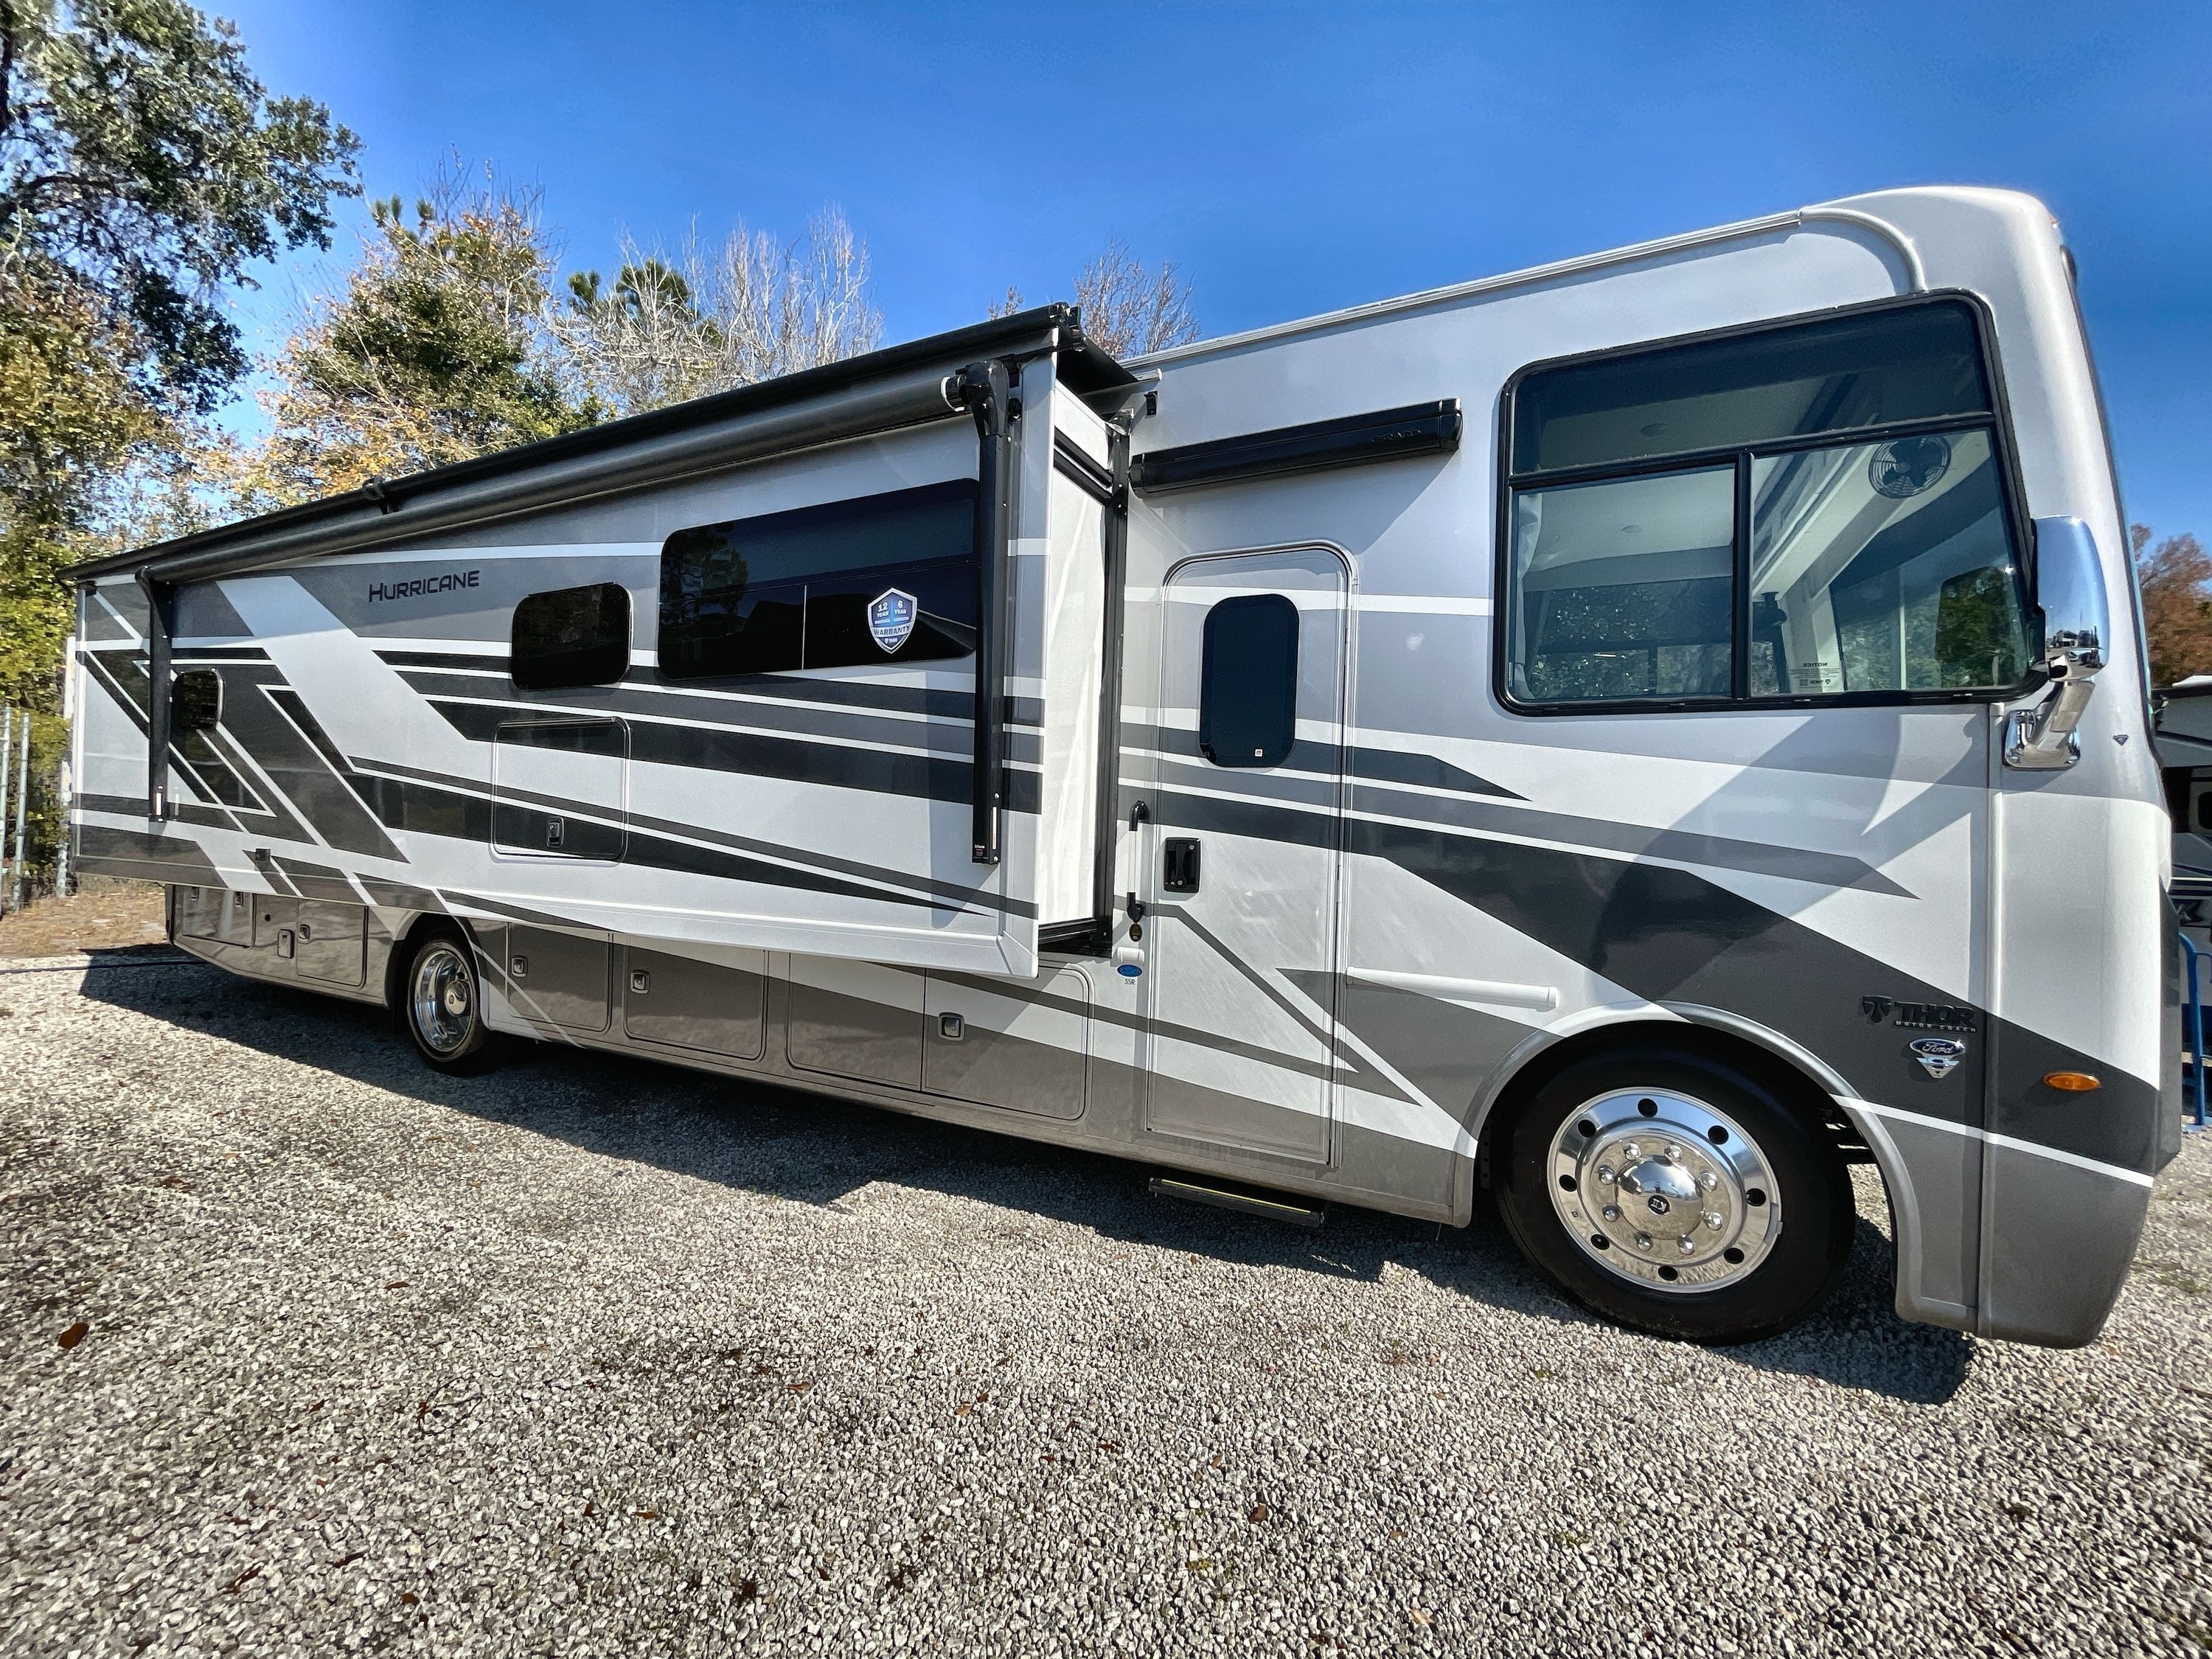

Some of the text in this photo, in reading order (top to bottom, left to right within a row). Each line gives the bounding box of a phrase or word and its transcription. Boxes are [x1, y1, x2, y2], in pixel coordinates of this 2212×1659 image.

[369, 570, 480, 602] HURRICANE
[877, 602, 888, 612] 12
[897, 599, 904, 609] 6
[873, 625, 910, 636] WARRANTY
[1893, 1001, 1975, 1026] THOR
[1922, 1041, 1953, 1054] Ford
